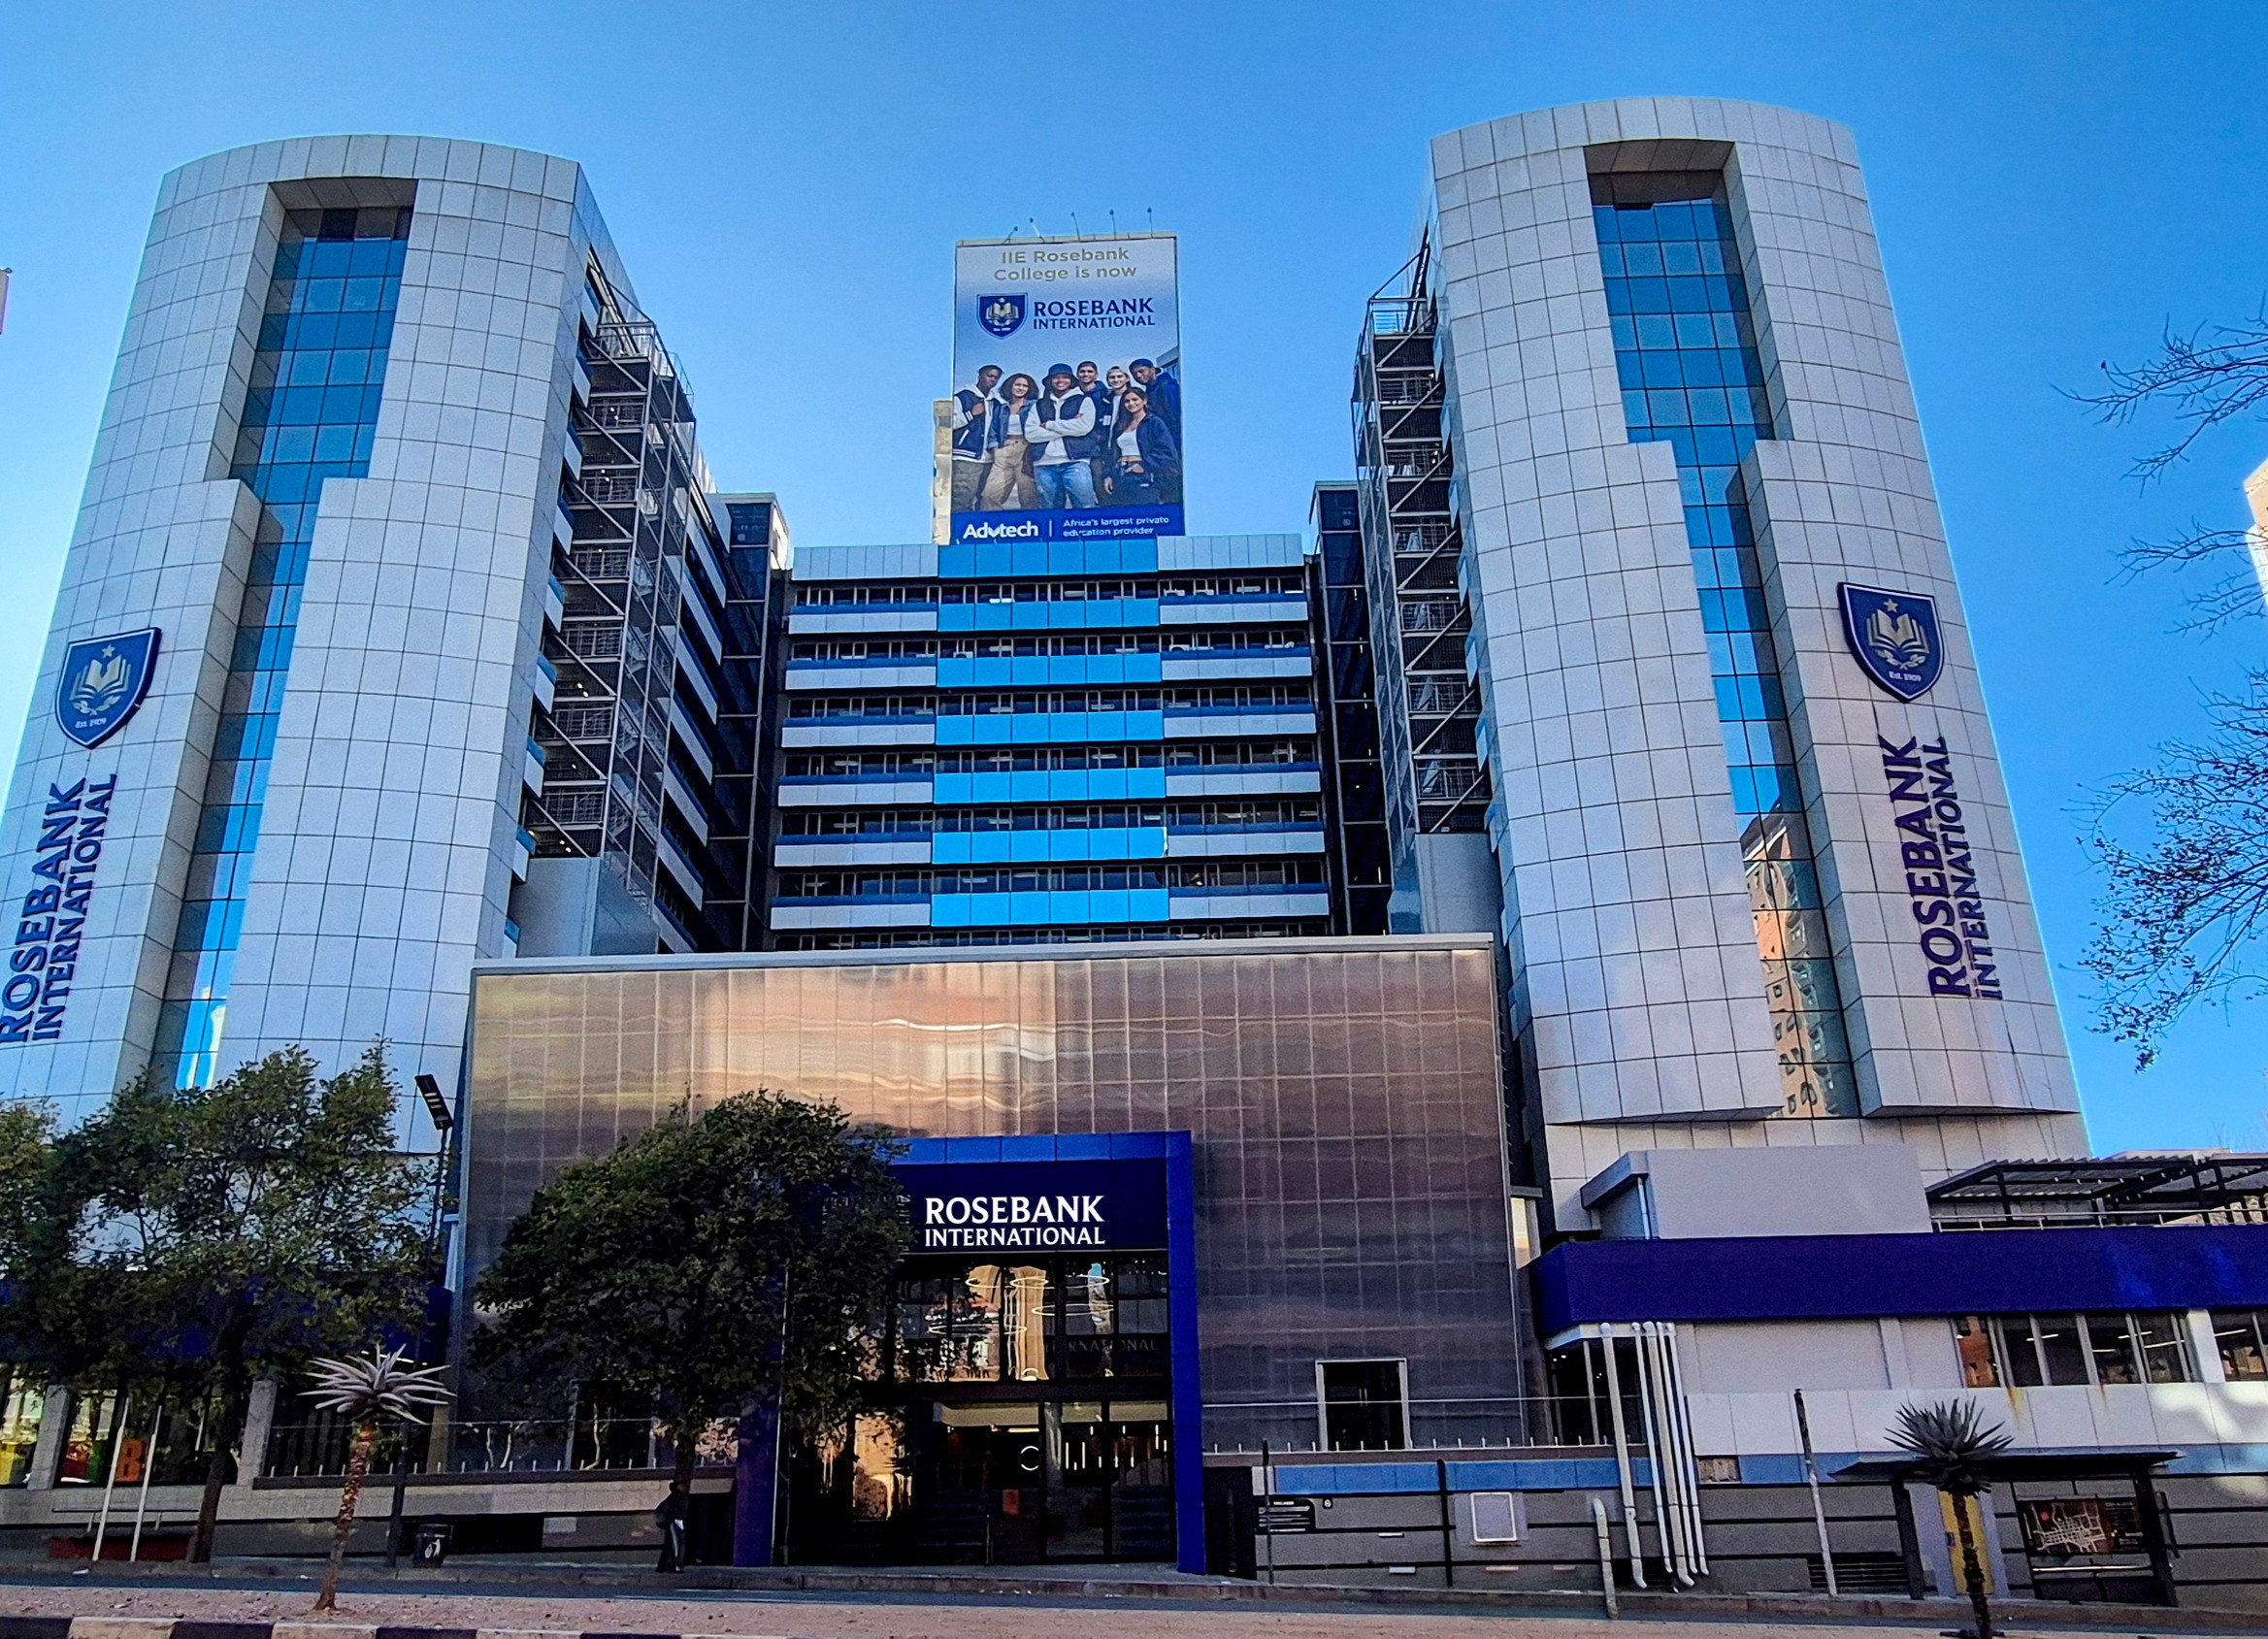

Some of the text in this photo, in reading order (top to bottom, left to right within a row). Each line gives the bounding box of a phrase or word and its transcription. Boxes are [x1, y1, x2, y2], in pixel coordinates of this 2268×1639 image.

[1002, 247, 1129, 264] IIE Rosebank
[994, 266, 1136, 281] College is now
[1034, 298, 1155, 316] ROSEBANK
[1034, 315, 1156, 330] INTERNATIONAL
[1063, 518, 1099, 527] Africa's
[1101, 517, 1134, 526] largest
[1113, 527, 1154, 536] provider
[1878, 734, 1972, 997] ROSEBANK
[1923, 737, 2002, 1000] INTERNATIONAL
[0, 777, 85, 1043] ROSEBANK
[33, 773, 116, 1040] INTERNATIONAL
[925, 1196, 1105, 1224] ROSEBANK
[925, 1227, 1105, 1247] INTERNATIONAL
